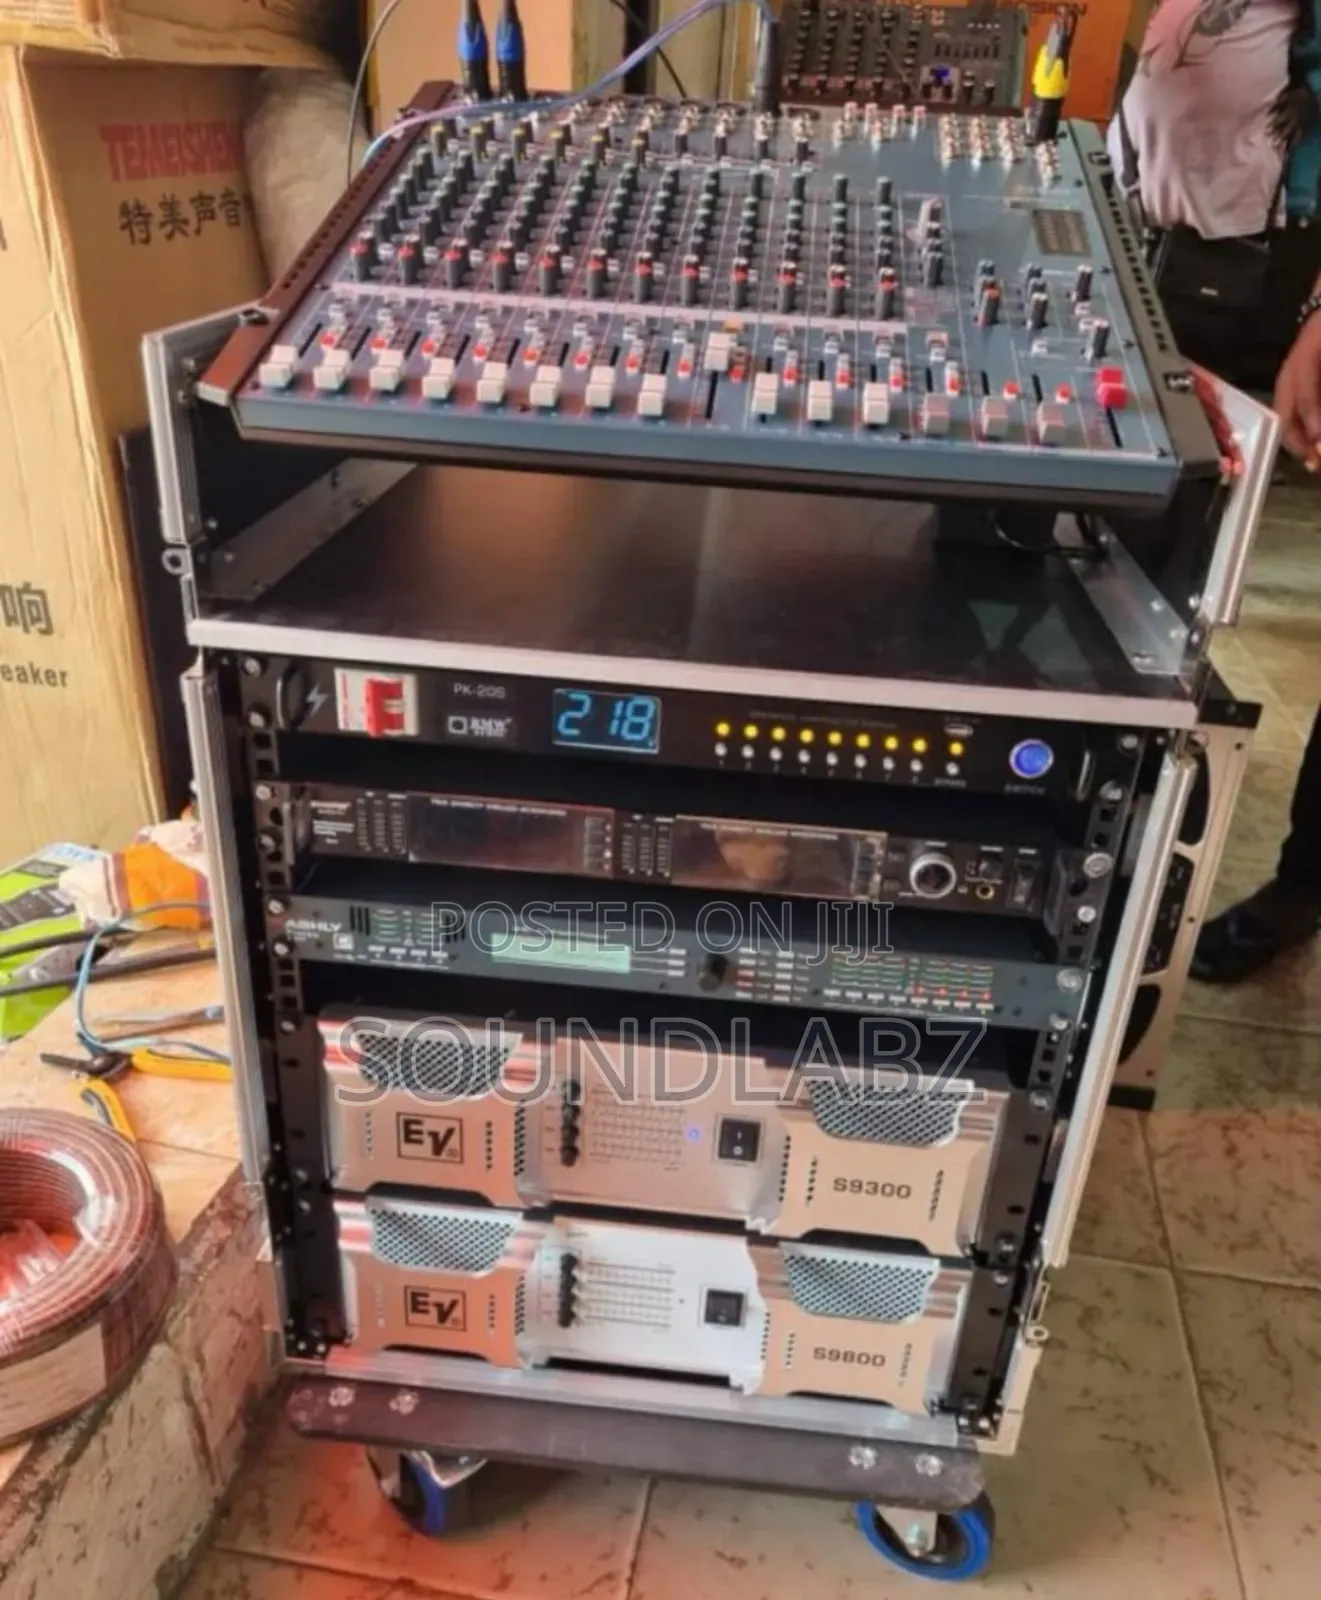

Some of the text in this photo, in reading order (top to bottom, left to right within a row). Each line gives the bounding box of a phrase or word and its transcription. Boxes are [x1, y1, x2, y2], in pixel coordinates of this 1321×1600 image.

[100, 121, 244, 182] TEMEISHE
[0, 661, 68, 688] eaker
[557, 693, 656, 741] 218
[403, 1118, 456, 1157] EV
[832, 1175, 912, 1200] S9300
[409, 1291, 459, 1326] EV
[812, 1345, 887, 1368] S9800
